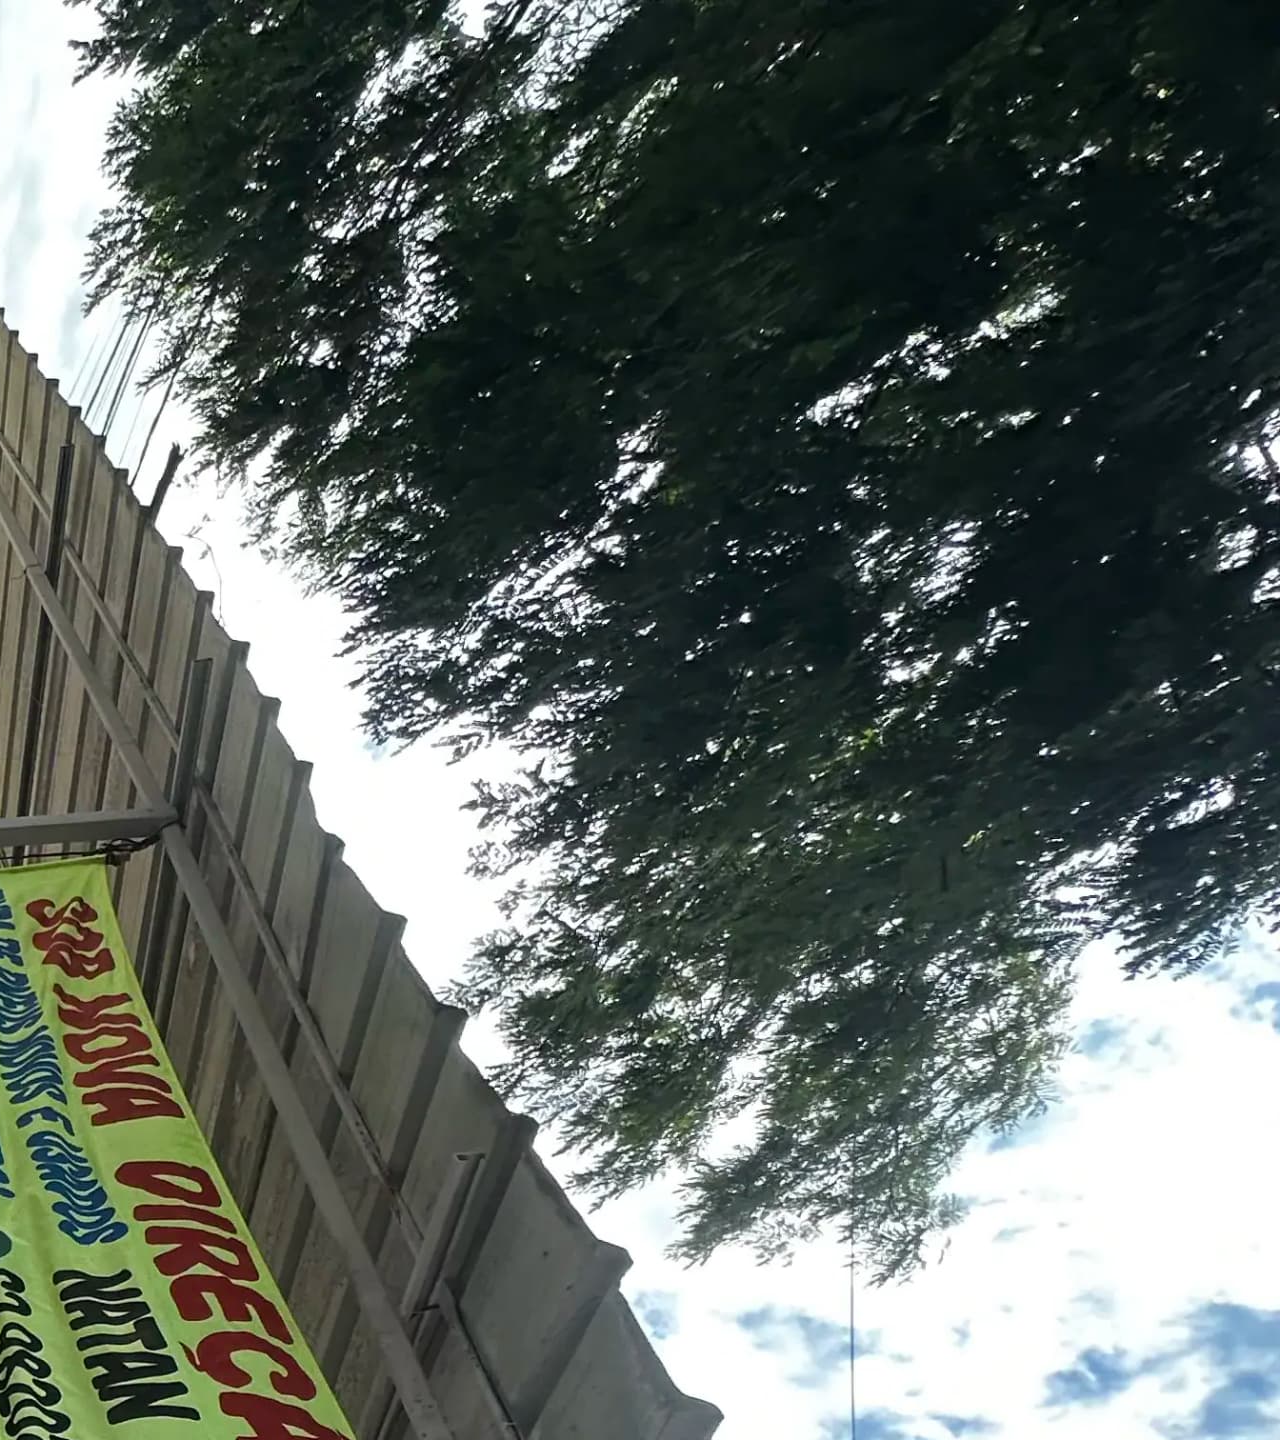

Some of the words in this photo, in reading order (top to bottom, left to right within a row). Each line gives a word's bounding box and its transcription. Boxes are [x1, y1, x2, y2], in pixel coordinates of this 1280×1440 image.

[26, 897, 116, 980] SOB
[53, 984, 185, 1127] NOVA
[16, 1107, 75, 1135] E
[26, 1132, 129, 1246] USADOS
[53, 1269, 201, 1425] NATAN
